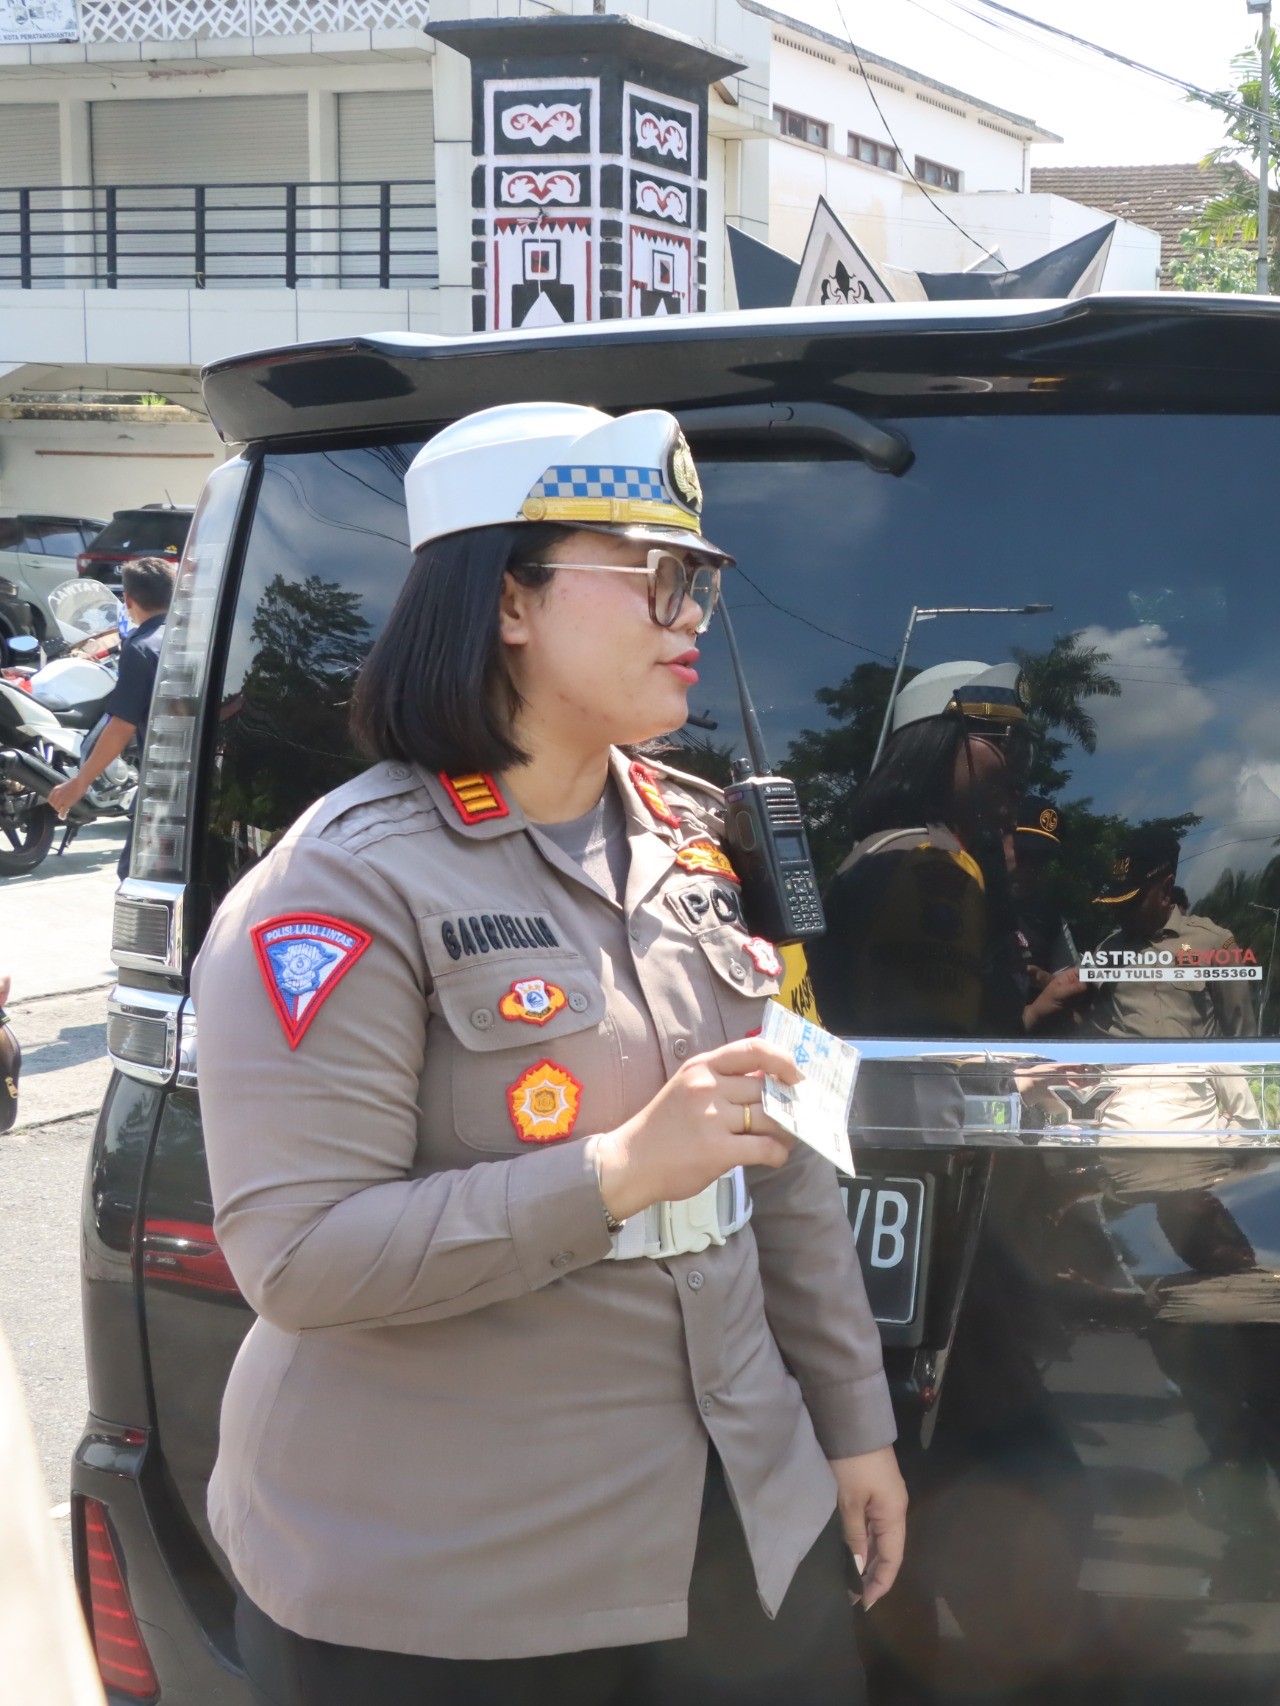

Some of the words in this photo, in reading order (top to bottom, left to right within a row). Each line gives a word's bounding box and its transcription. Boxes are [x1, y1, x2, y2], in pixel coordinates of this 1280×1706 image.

[266, 925, 293, 942] POLISI
[296, 924, 319, 935] LALU
[322, 926, 354, 948] LINTAS
[1177, 948, 1257, 966] TOYOTA
[1087, 969, 1121, 979] BATU
[1125, 969, 1164, 979] TULIS
[1194, 968, 1257, 979] 3855360
